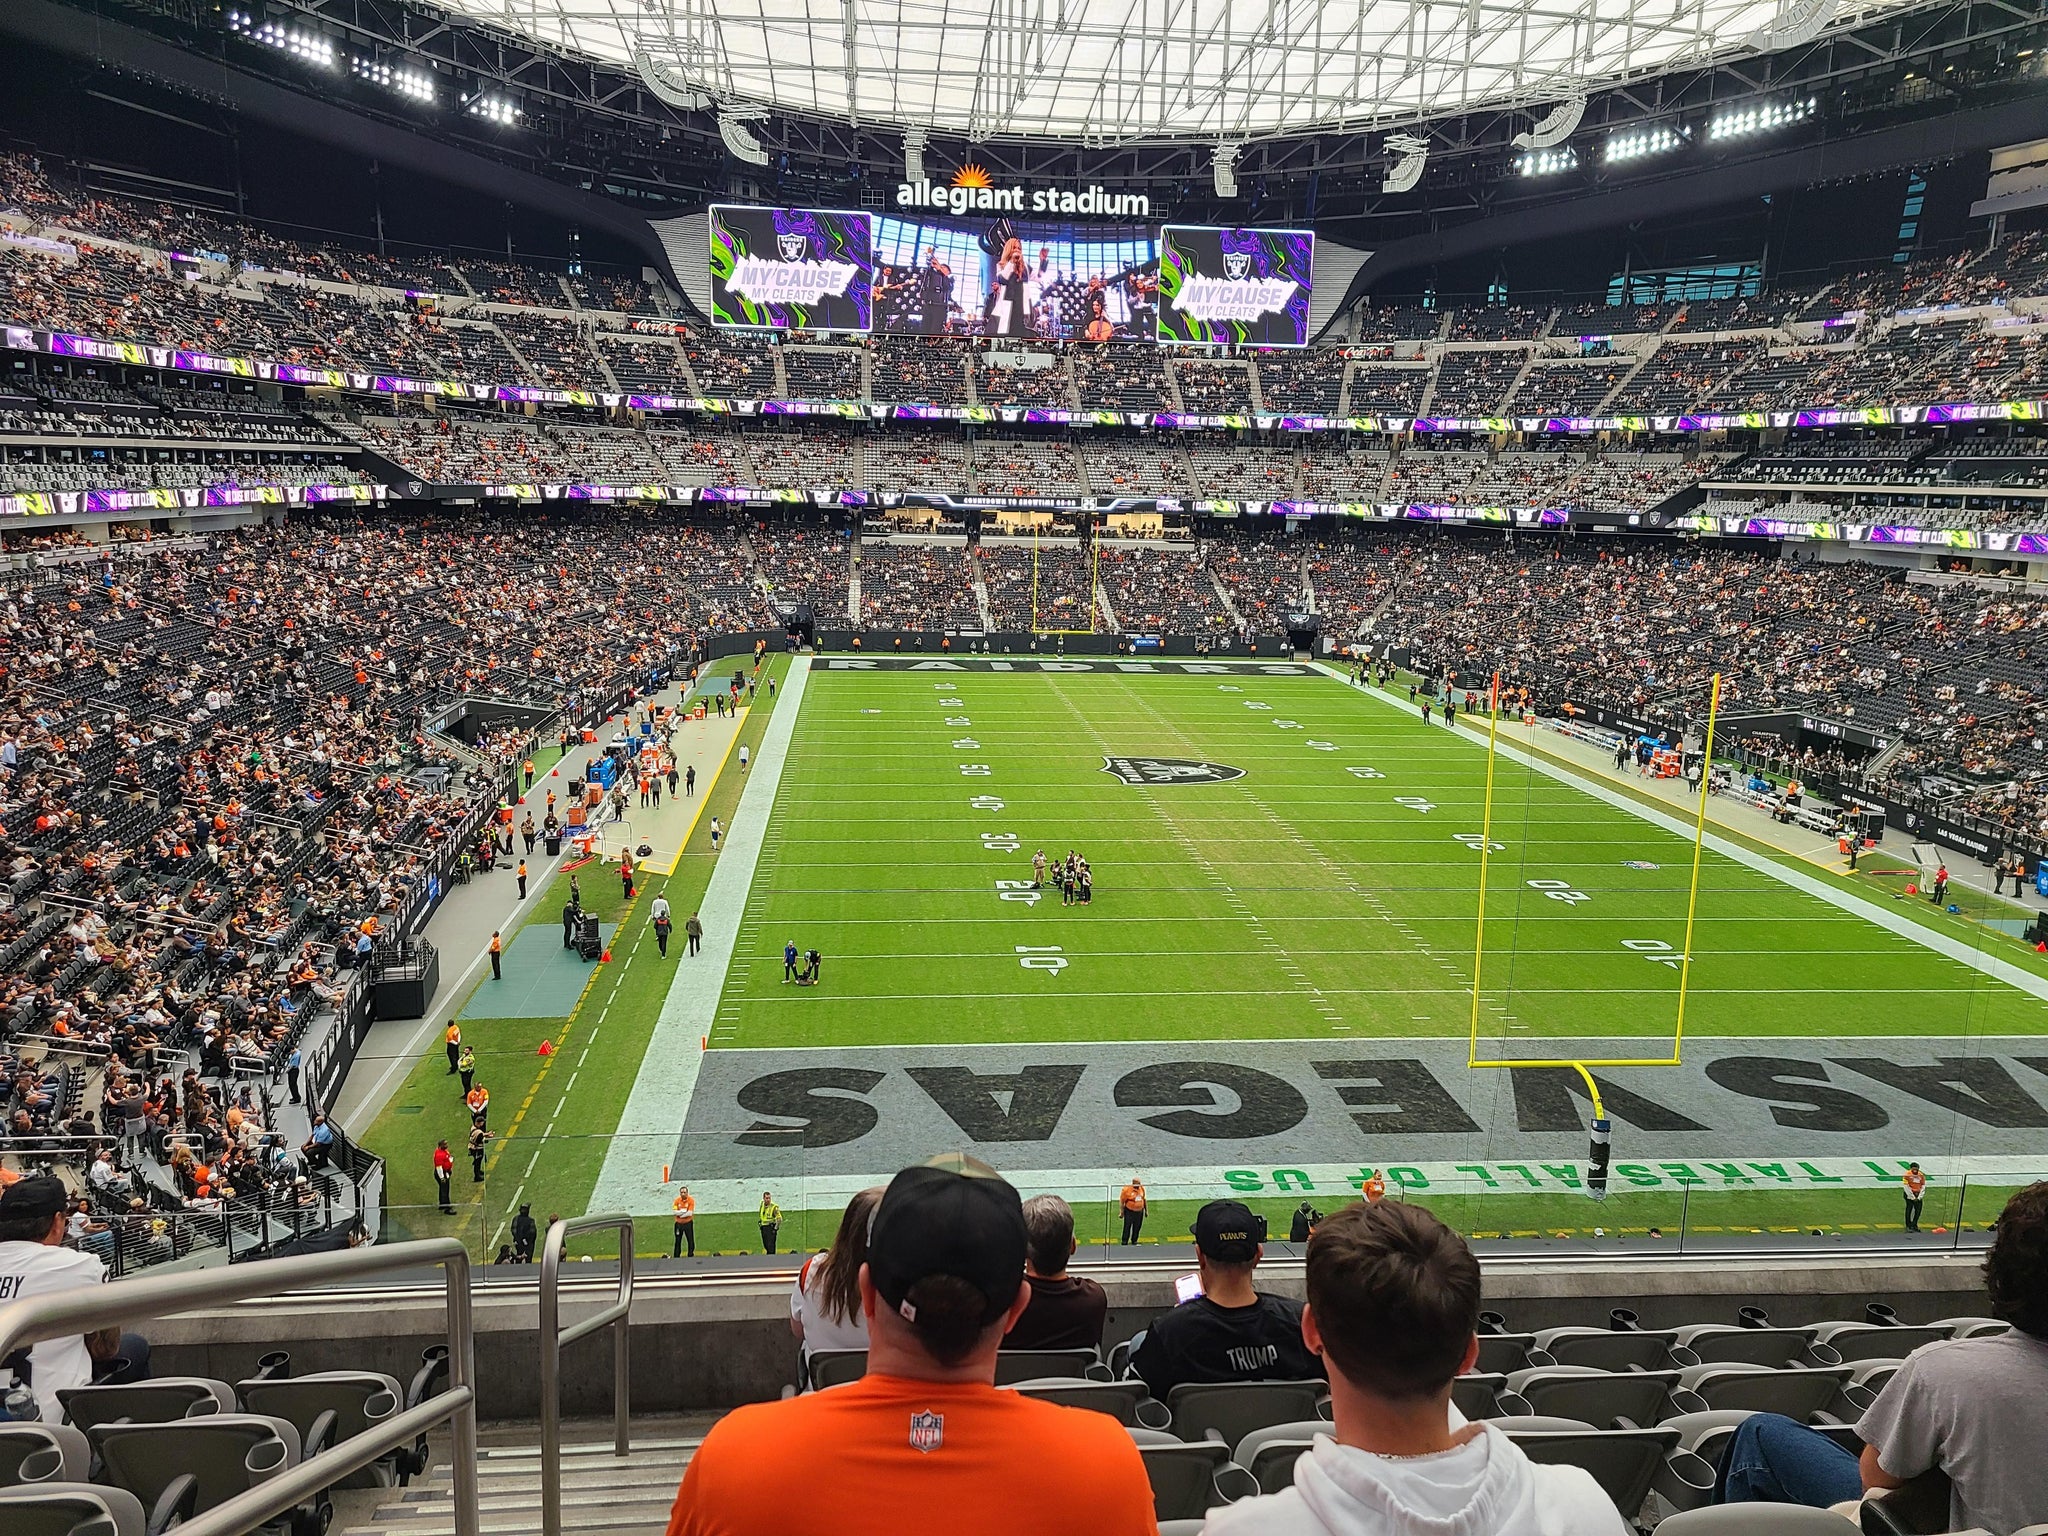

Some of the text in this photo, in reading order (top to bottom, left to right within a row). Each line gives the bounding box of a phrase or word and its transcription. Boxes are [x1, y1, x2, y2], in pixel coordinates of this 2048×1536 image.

[896, 178, 1149, 215] allegiant stadium
[741, 266, 842, 288] MY CAUSE
[752, 288, 814, 300] MY CLEATS
[1187, 285, 1282, 305] MY CAUSE
[1196, 305, 1256, 317] MY CLEATS
[827, 660, 1306, 675] RAIDERS
[1819, 722, 1839, 736] 17:19
[959, 764, 992, 777] 50
[1345, 766, 1386, 778] 50
[969, 795, 1005, 810] 40
[1393, 796, 1438, 813] 40
[980, 832, 1021, 850] 30
[1451, 833, 1506, 852] 30
[995, 879, 1042, 902] 20
[1526, 879, 1593, 902] 20
[1014, 945, 1069, 970] 10
[1620, 939, 1694, 963] 10
[734, 1059, 1713, 1147] VEGAS
[1224, 1169, 1316, 1192] US
[1455, 1164, 1583, 1188] ALL
[1615, 1162, 1845, 1187] TAKES
[1219, 1231, 1248, 1241] PEANUTS
[0, 1275, 26, 1299] BY
[1226, 1345, 1278, 1371] TRUMP
[915, 1429, 938, 1446] NFL
